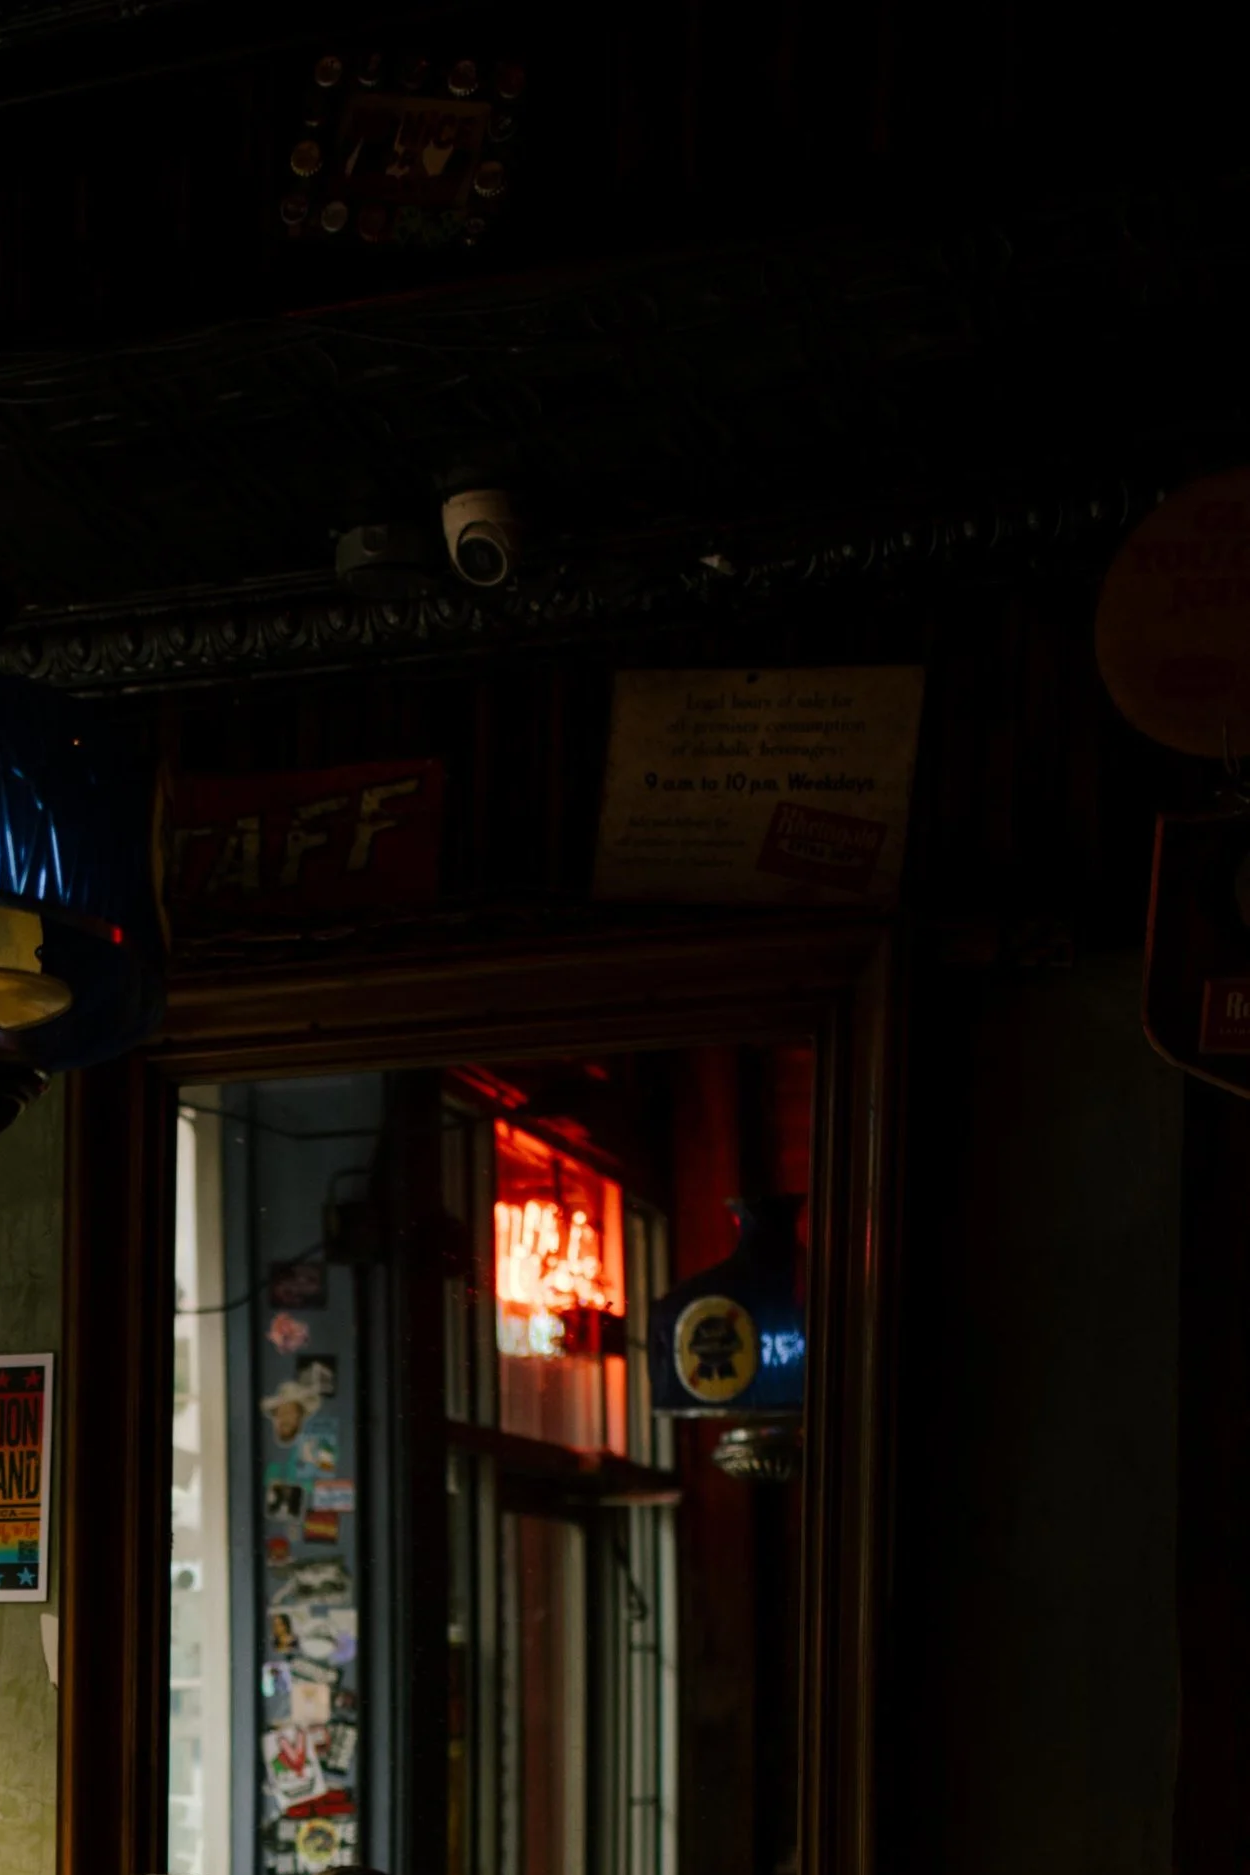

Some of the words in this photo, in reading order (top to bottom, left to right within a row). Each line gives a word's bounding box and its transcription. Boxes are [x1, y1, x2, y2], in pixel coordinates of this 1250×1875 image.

[645, 771, 659, 790] 9
[701, 775, 719, 791] to
[726, 771, 747, 791] 10
[787, 771, 875, 795] Weekdays
